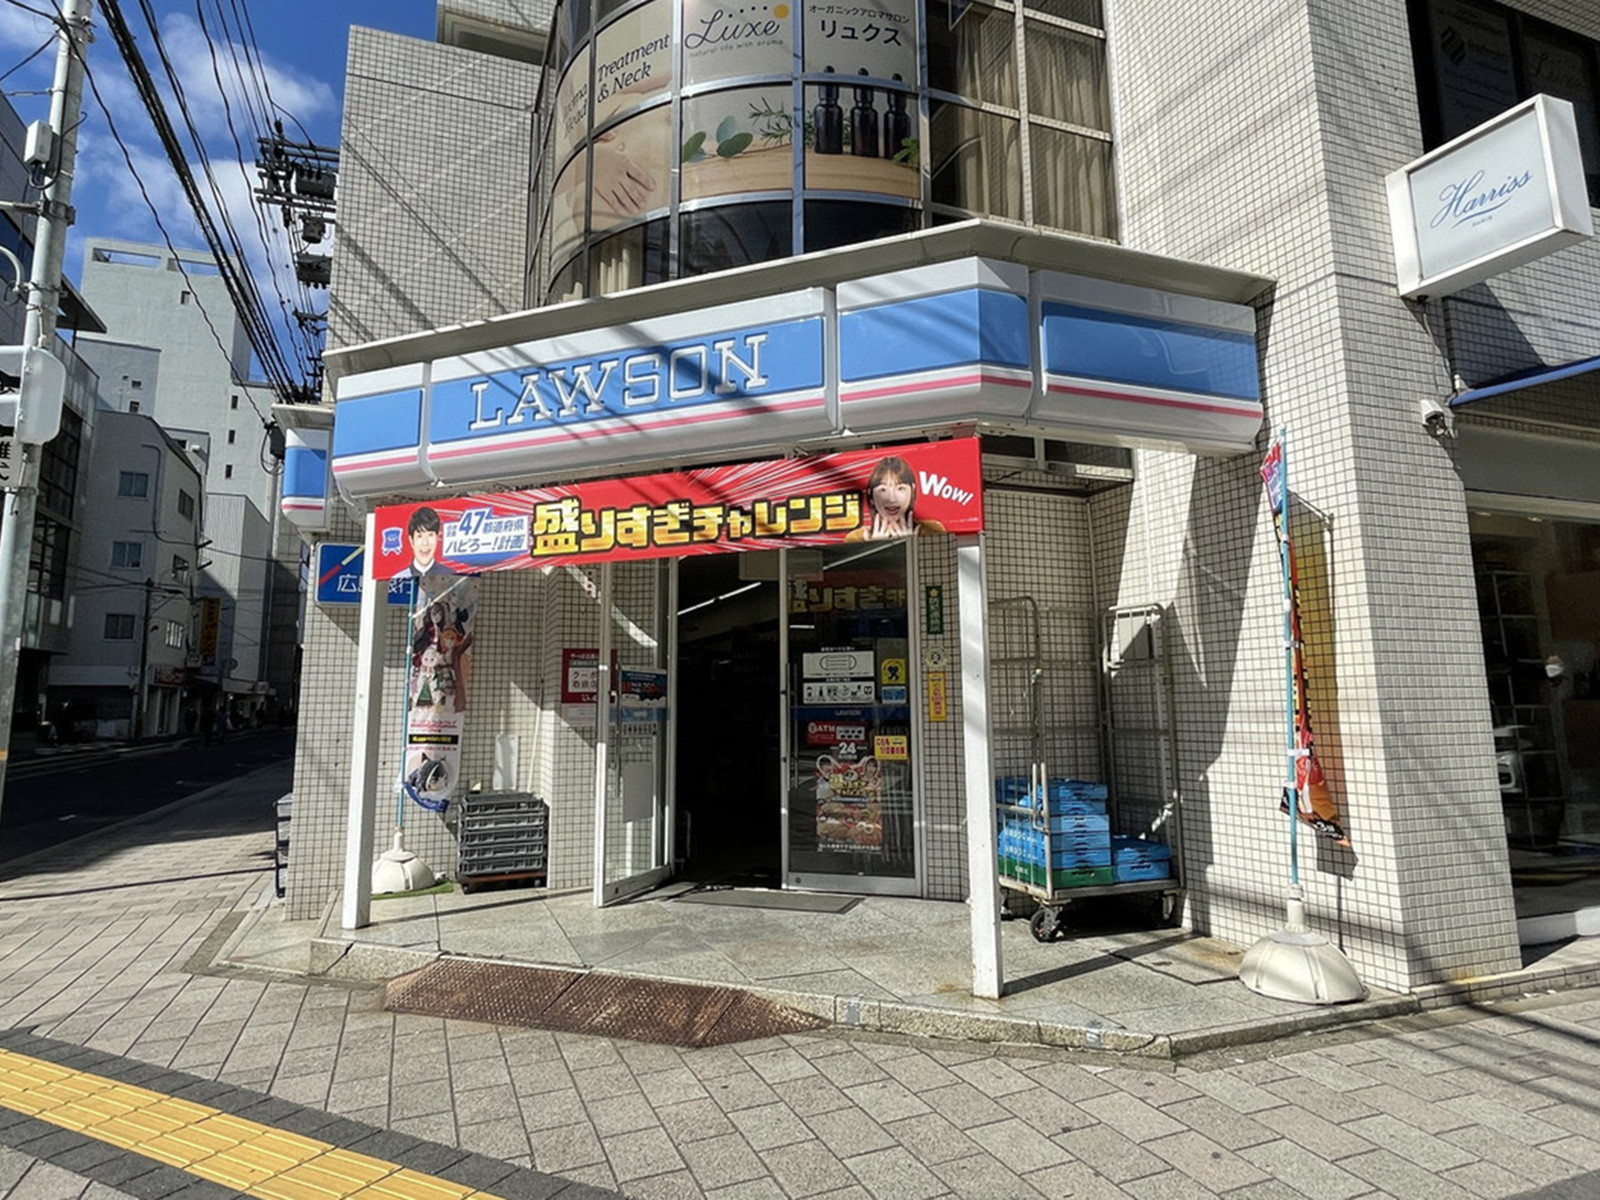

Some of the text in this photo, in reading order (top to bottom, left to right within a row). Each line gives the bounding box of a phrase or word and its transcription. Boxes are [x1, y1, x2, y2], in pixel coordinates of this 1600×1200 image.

[685, 9, 781, 50] Luxe
[809, 5, 910, 24] オーガニックアロマサロン
[820, 19, 901, 46] リュクス
[597, 33, 670, 83] Treatment
[597, 82, 609, 103] &
[611, 61, 651, 96] Neck
[1430, 170, 1532, 228] Harriss
[468, 332, 768, 431] LAWSON
[458, 511, 525, 536] 47都道府県
[532, 490, 862, 557] 盛りすぎチャレンジ
[817, 725, 836, 733] ATM
[838, 742, 857, 755] 24
